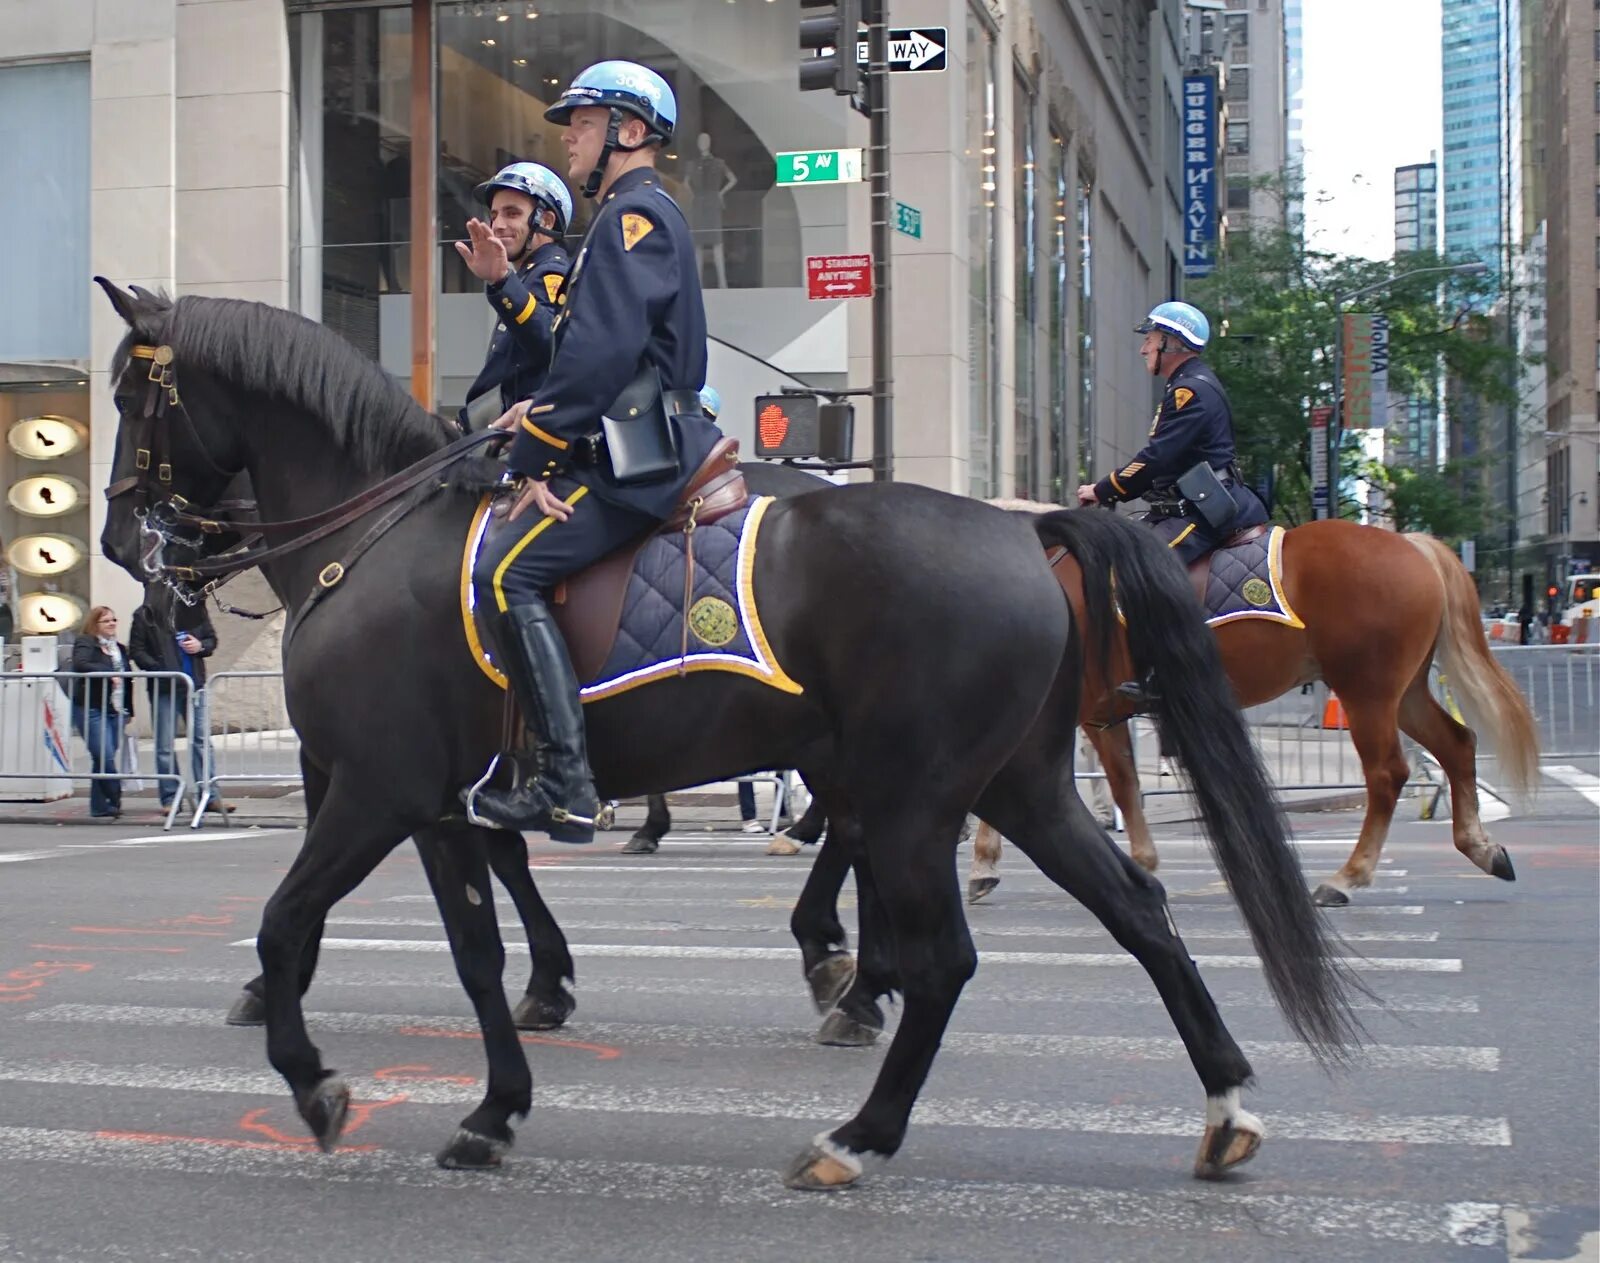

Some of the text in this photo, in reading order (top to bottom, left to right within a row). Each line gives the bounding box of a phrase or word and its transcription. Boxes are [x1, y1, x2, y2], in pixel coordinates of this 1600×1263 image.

[894, 42, 929, 59] WAY
[1186, 82, 1207, 162] BURGER
[792, 153, 832, 181] 5 AV
[1186, 167, 1213, 260] HEAVEN
[809, 257, 869, 270] NO STANDING
[817, 270, 863, 281] ANYTIME
[1371, 314, 1389, 374] MoMA
